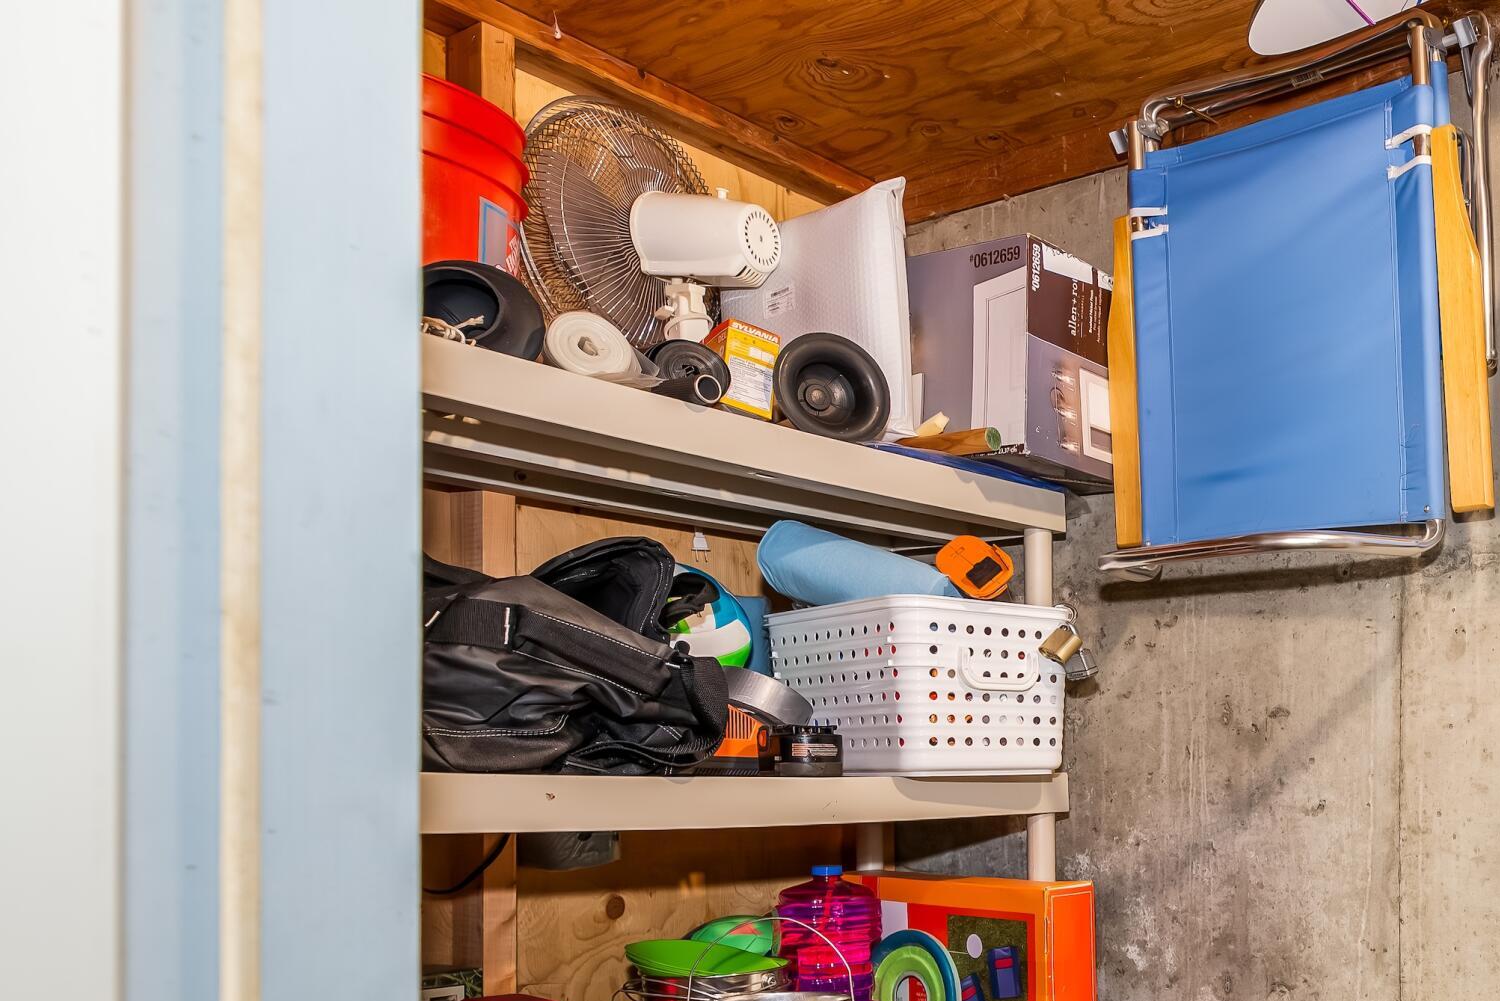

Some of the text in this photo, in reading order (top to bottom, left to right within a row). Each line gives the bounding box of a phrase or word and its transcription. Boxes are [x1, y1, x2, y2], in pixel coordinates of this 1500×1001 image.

[970, 245, 1021, 268] #0612659
[1031, 243, 1041, 292] #0612659
[731, 321, 779, 344] SYLVANIA
[1068, 307, 1077, 337] allen
